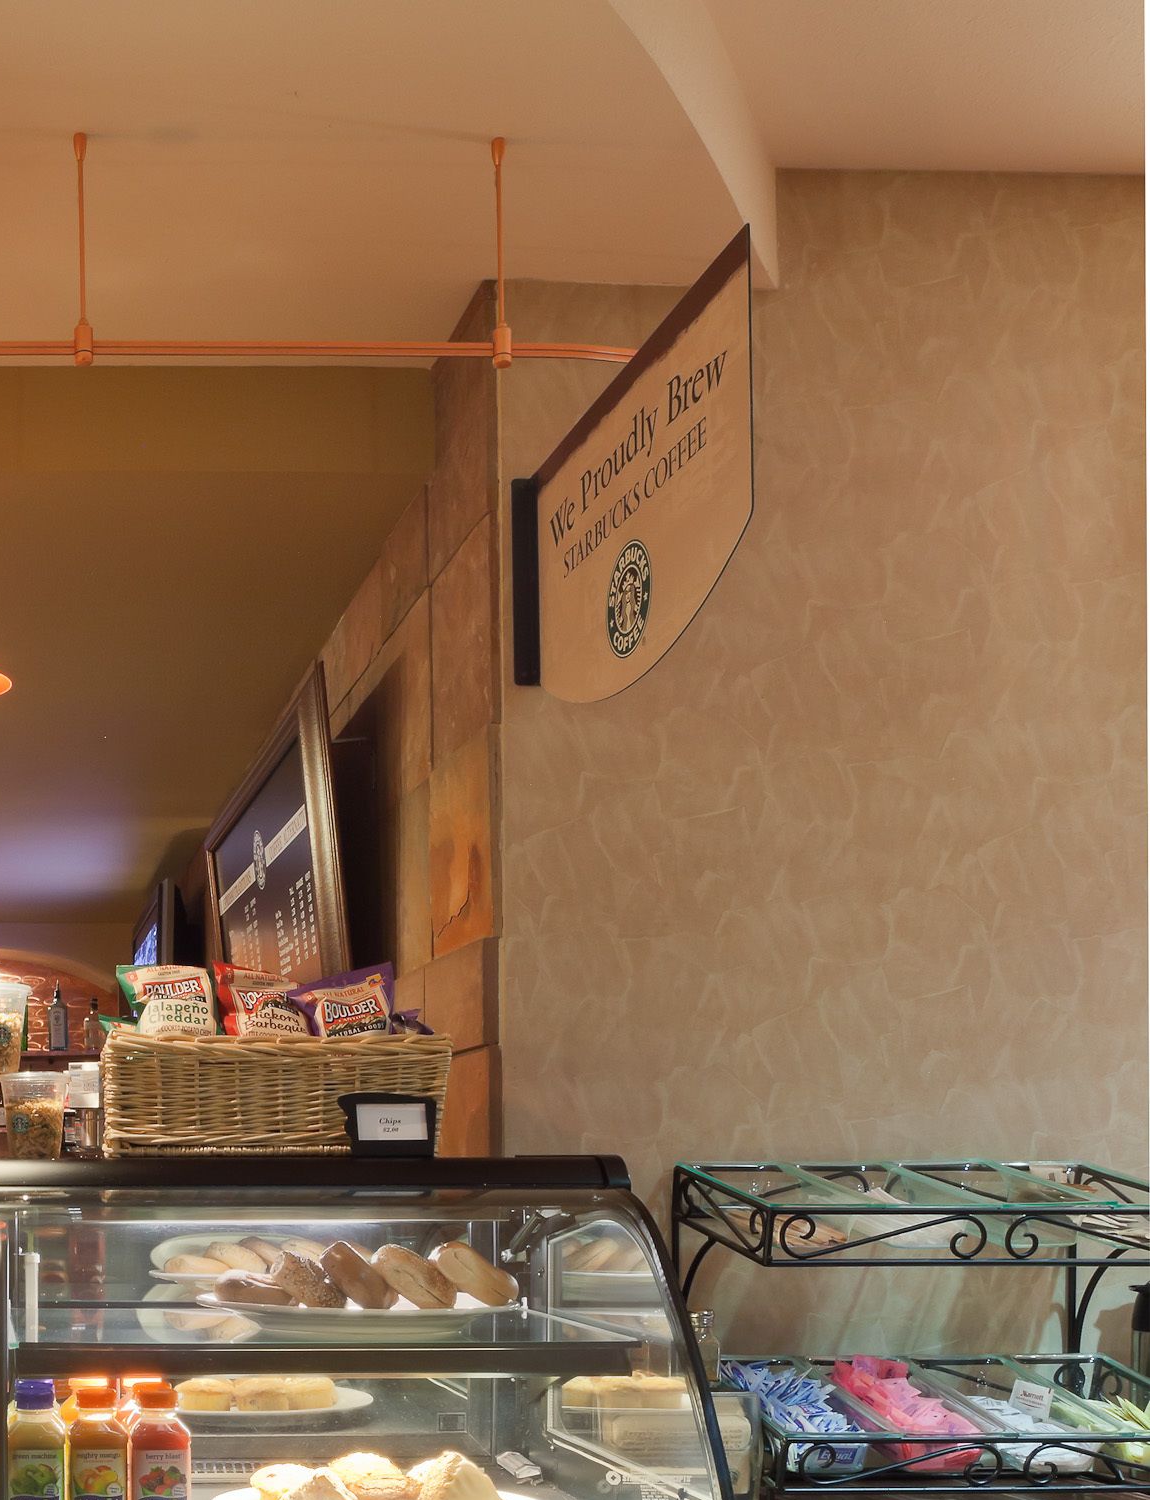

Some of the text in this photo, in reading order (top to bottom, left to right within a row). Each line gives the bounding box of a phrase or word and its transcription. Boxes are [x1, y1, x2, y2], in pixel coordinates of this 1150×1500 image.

[549, 351, 727, 549] We Proudly Brew
[563, 416, 708, 578] STARBUCKS COFFEE
[608, 546, 649, 607] STARBUCKS
[613, 618, 645, 652] COFFEE
[146, 979, 202, 998] BOULDER
[323, 999, 380, 1022] BOULDER
[379, 1117, 401, 1126] Chips
